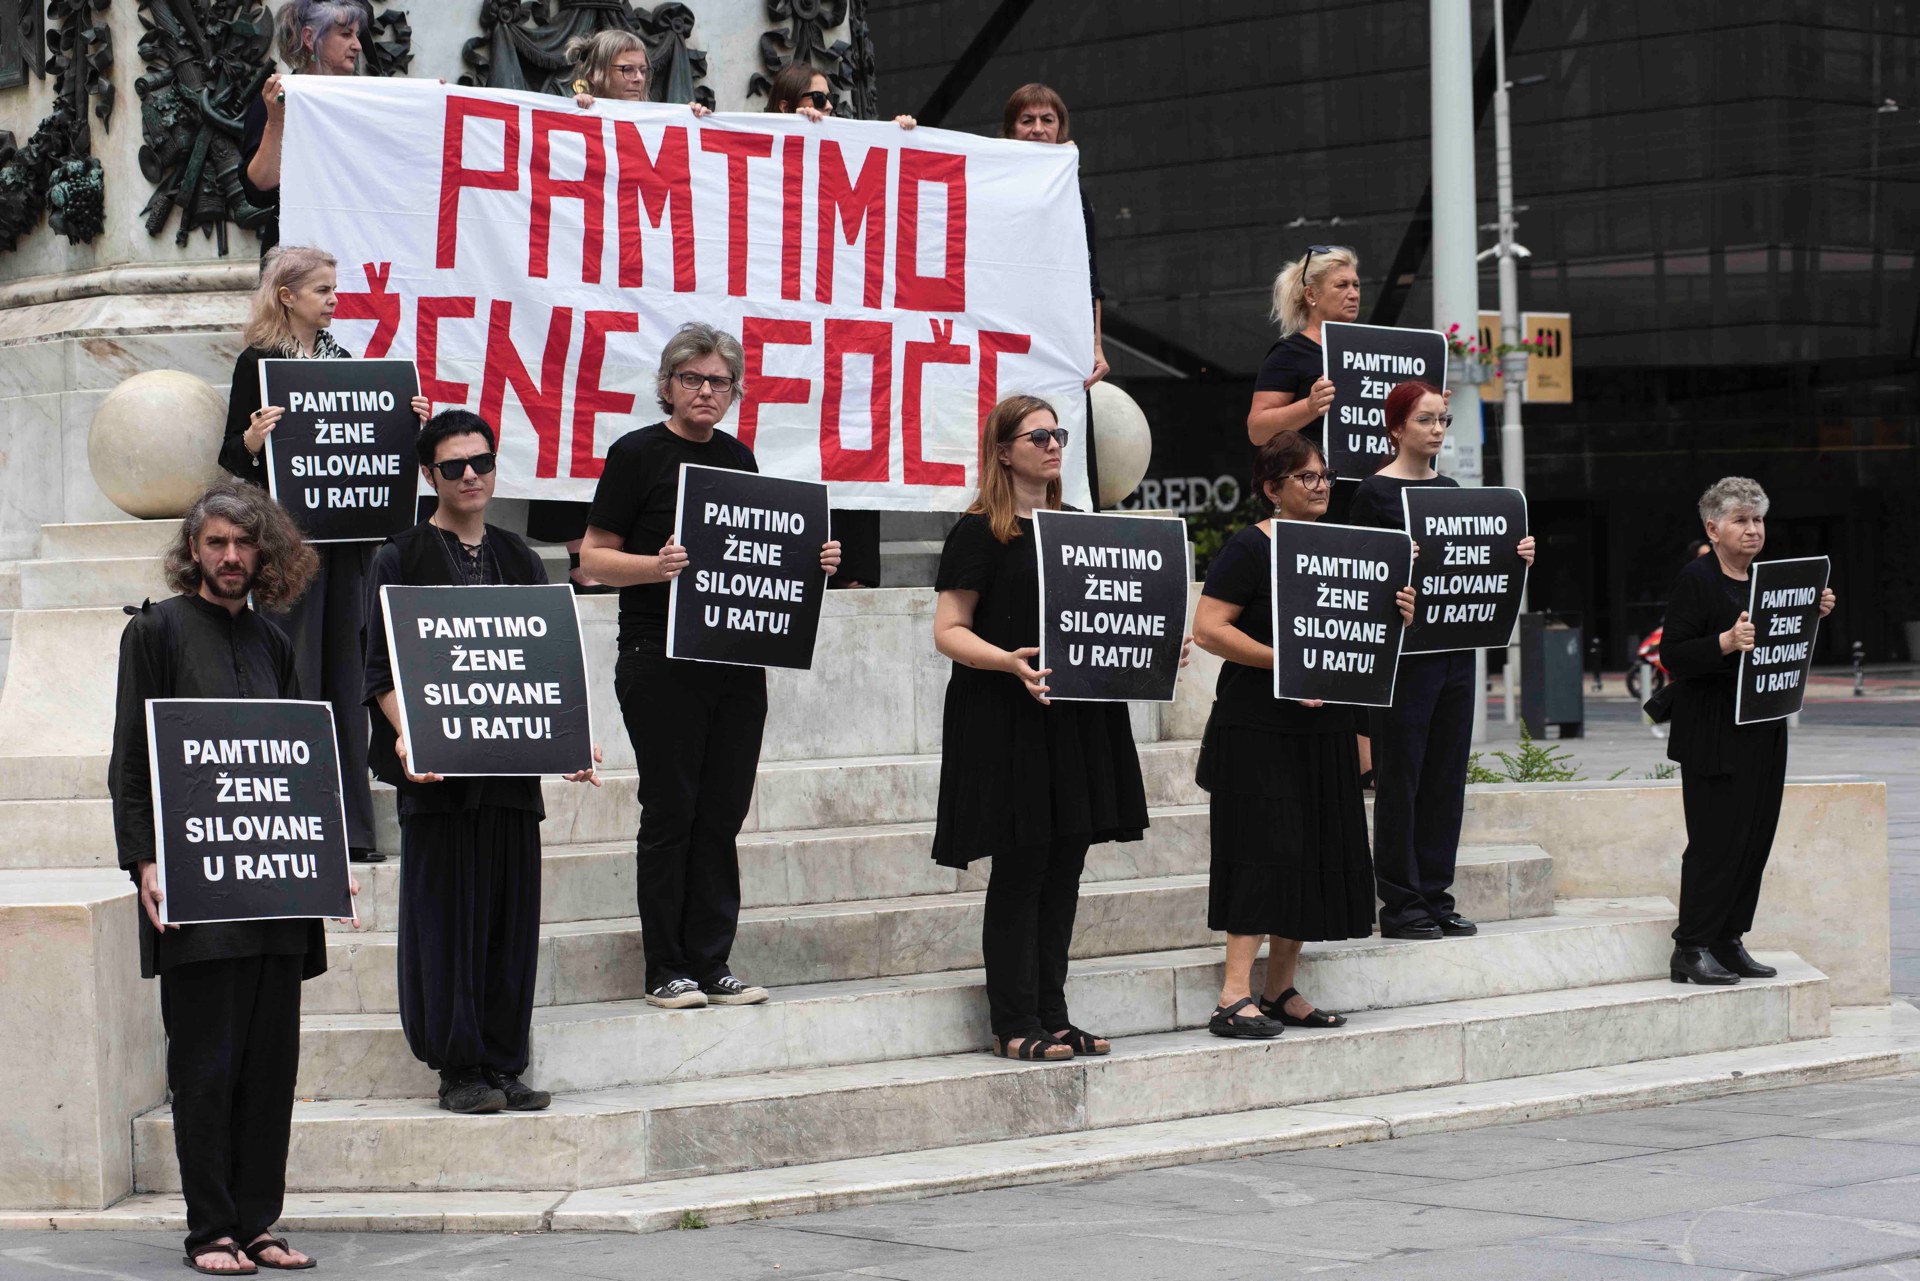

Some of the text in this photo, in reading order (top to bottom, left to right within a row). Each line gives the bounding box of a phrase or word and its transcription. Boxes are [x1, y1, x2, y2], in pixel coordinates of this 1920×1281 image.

[436, 96, 966, 312] PAMTIMO
[1343, 351, 1426, 376] PAMTIMO
[1360, 376, 1400, 399] ŽEN
[289, 390, 395, 412] PAMTIMO
[314, 418, 376, 444] ŽENE
[1348, 434, 1361, 453] U
[291, 454, 400, 476] SILOVANE
[305, 486, 390, 508] U RATU!
[704, 502, 805, 536] PAMTIMO
[1425, 515, 1508, 536] PAMTIMO
[723, 534, 783, 567] ŽENE
[1060, 544, 1163, 571] PAMTIMO
[1444, 542, 1491, 565] ŽENE
[1296, 553, 1389, 582] PAMTIMO
[695, 569, 804, 604] SILOVANE
[1084, 577, 1143, 602] ŽENE
[1316, 582, 1369, 612] ŽENE
[1422, 574, 1509, 595] SILOVANE
[1761, 587, 1815, 609] PAMTIMO
[704, 604, 791, 635] U RATU!
[1059, 610, 1166, 637] SILOVANE
[1426, 603, 1497, 624] U RATU!
[1769, 613, 1802, 636] ŽENE
[416, 616, 548, 638] PAMTIMO
[1293, 615, 1387, 643] SILOVANE
[450, 645, 526, 671] ŽENE
[1069, 645, 1152, 669] U RATU!
[1303, 649, 1376, 674] U RATU!
[1752, 641, 1809, 665] SILOVANE
[1755, 669, 1801, 693] U RATU!
[424, 683, 562, 706] SILOVANE
[442, 717, 552, 740] U RATU!
[183, 740, 310, 766] PAMTIMO
[216, 771, 291, 802] ŽENE
[185, 815, 325, 842] SILOVANE
[204, 854, 317, 881] U RATU!
